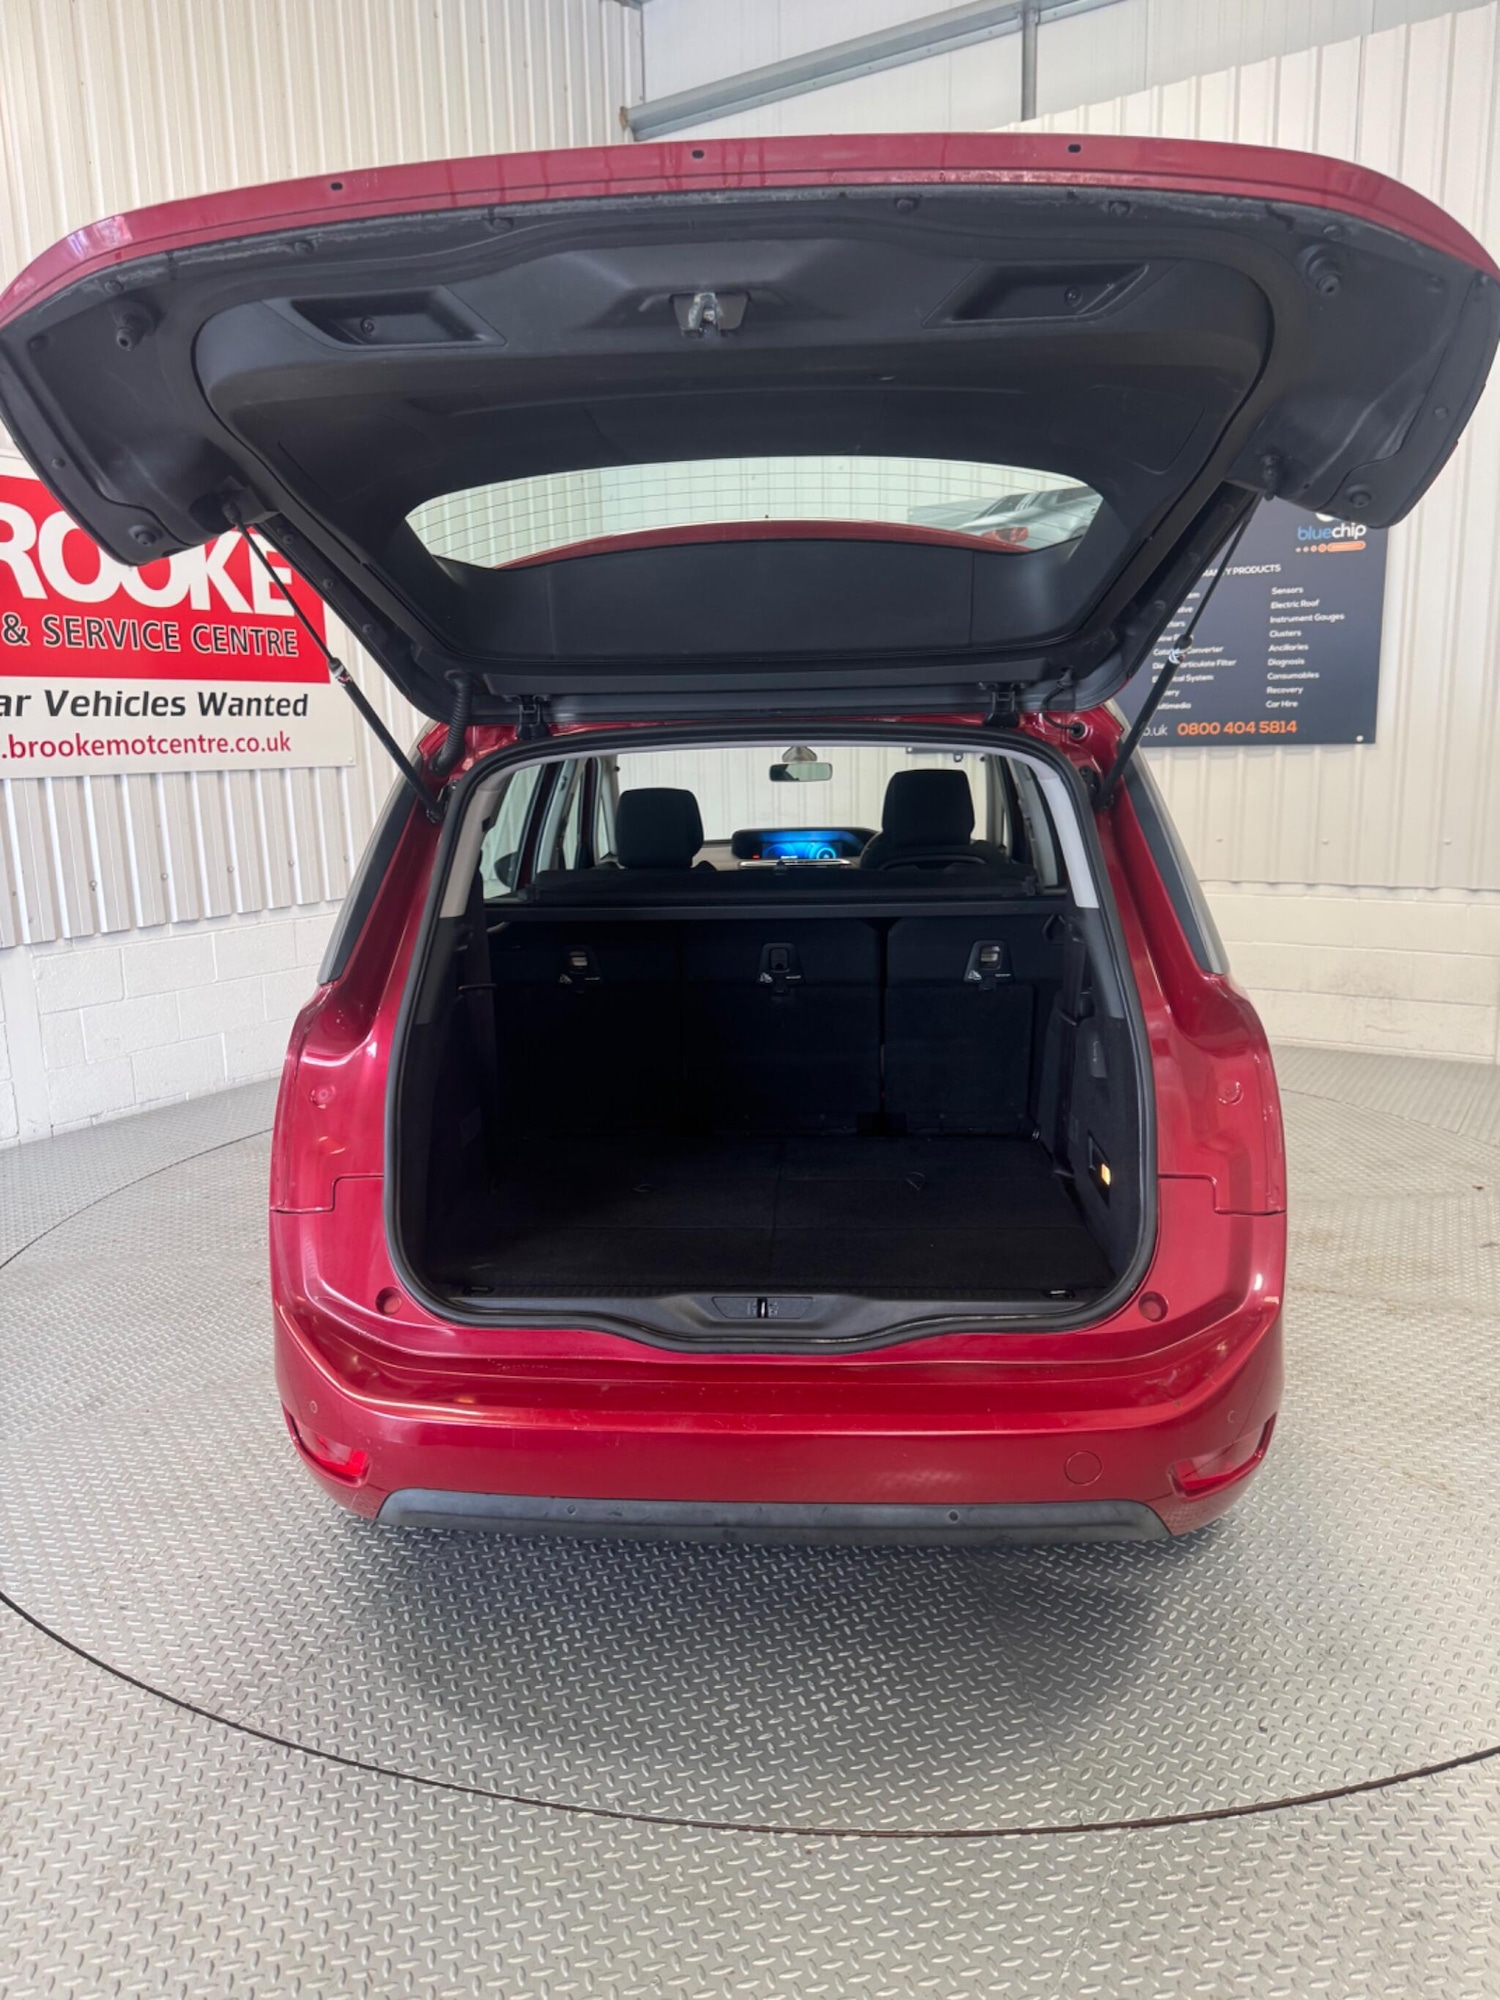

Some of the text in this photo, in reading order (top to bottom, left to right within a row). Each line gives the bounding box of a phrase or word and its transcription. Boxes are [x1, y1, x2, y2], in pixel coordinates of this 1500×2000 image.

[1297, 522, 1367, 541] bluechip
[1233, 563, 1281, 575] PRODUCTS
[1271, 586, 1304, 595] Sensors
[1270, 598, 1320, 609] Electric Roof
[1269, 612, 1345, 623] Instrument Gauges
[1, 612, 299, 657] & SERVICE CENTRE
[1269, 629, 1302, 638] Clusters
[1268, 643, 1309, 652] Ancillaries
[1217, 659, 1237, 667] Filter
[1267, 658, 1305, 668] Diagnosis
[1186, 674, 1214, 683] System
[1267, 671, 1320, 680] Consumables
[1266, 686, 1304, 695] Recovery
[44, 689, 187, 718] Vehicles
[197, 691, 309, 718] Wanted
[1265, 700, 1298, 708] Car Hire
[1177, 722, 1221, 736] 0800
[1223, 721, 1256, 735] 404
[1259, 720, 1297, 734] 5814
